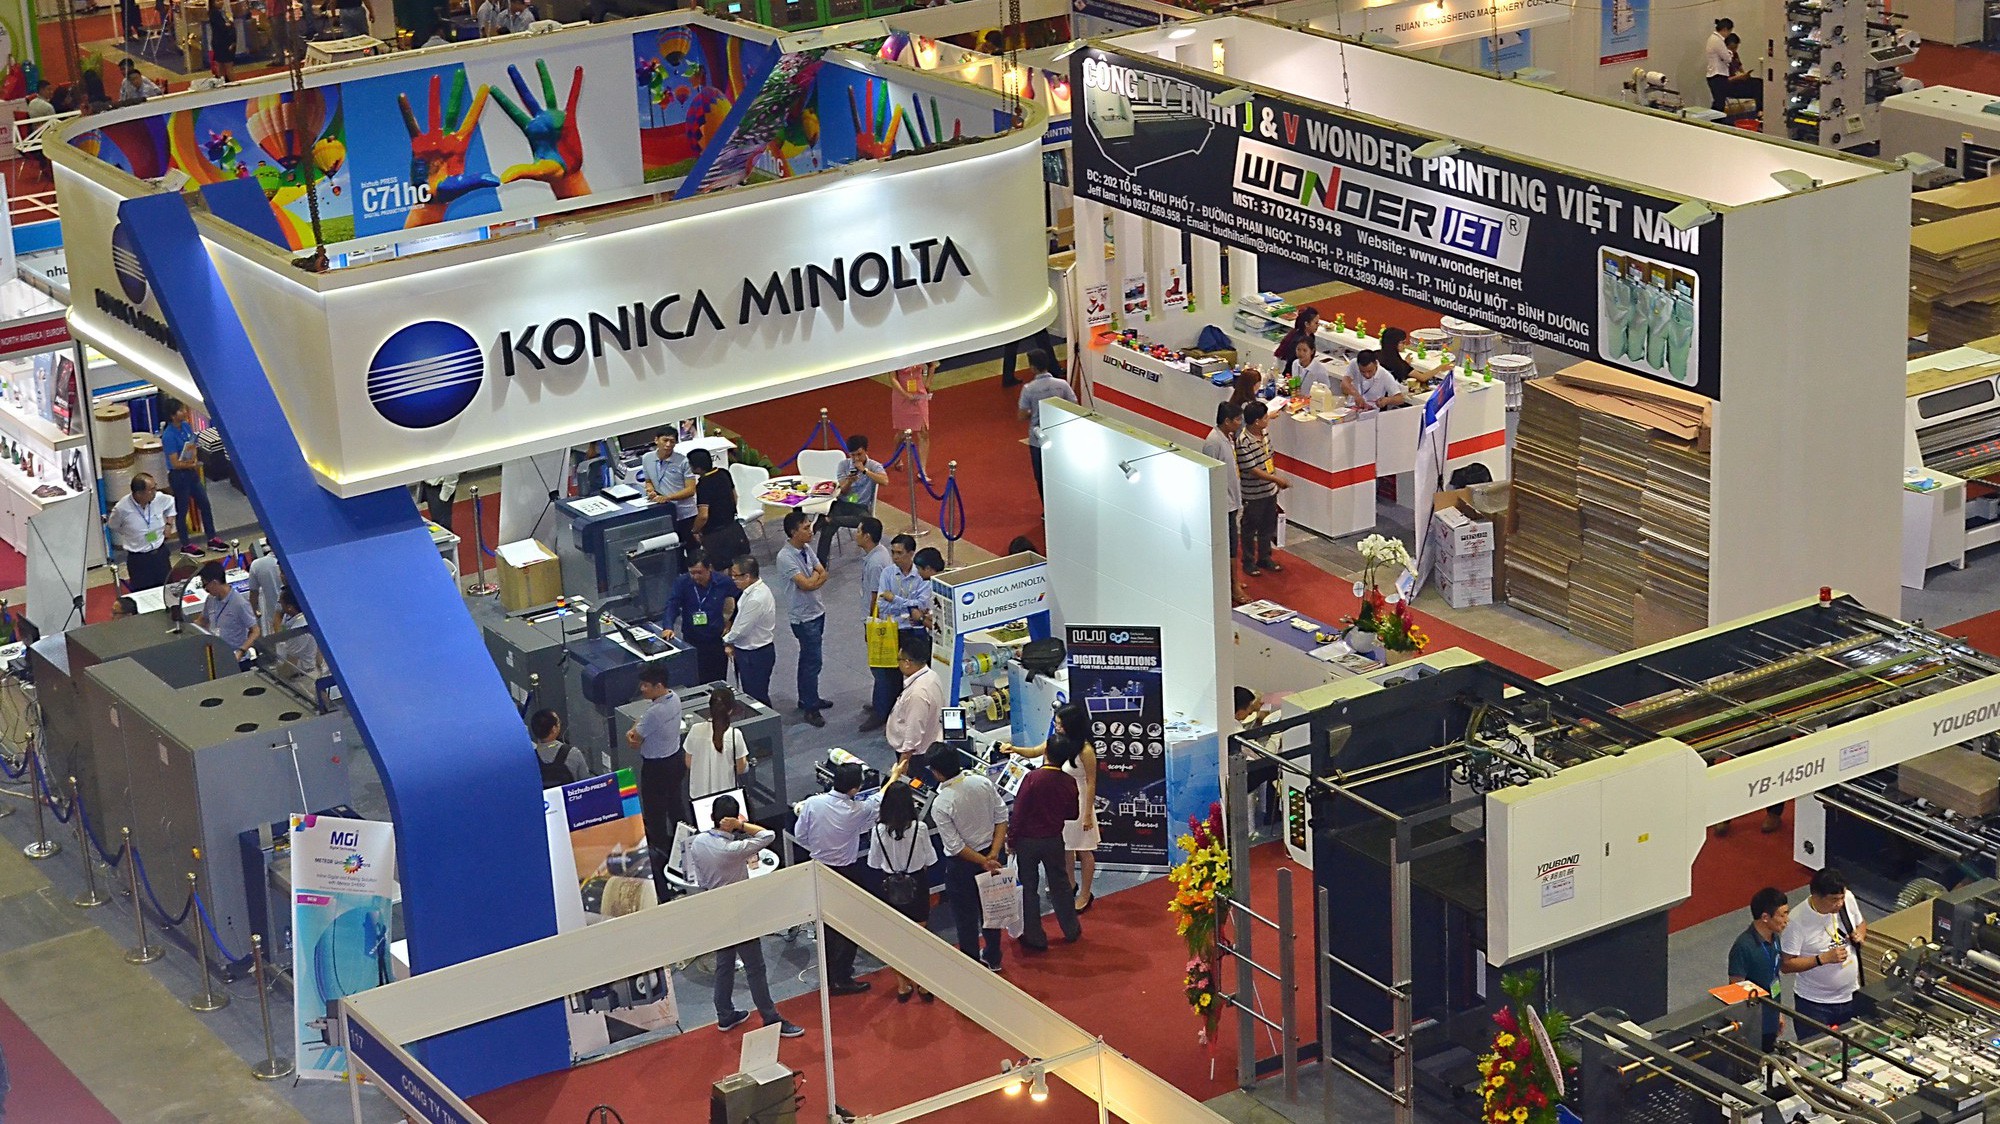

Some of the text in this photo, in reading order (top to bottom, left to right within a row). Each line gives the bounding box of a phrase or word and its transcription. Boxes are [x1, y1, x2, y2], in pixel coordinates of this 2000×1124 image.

[1395, 21, 1421, 33] RUIAN
[1083, 54, 1139, 100] CÔNG
[1143, 72, 1172, 108] TY
[1243, 101, 1254, 133] J
[1259, 106, 1279, 141] &
[1282, 111, 1300, 146] V
[1305, 118, 1413, 178] WONDER
[1421, 154, 1548, 215] PRINTING
[1556, 184, 1623, 235] VIỆT
[1632, 204, 1700, 256] NAM
[362, 181, 432, 213] C71hc
[1232, 191, 1343, 237] MST: 3702475948
[1086, 168, 1103, 184] ĐC:
[1103, 174, 1119, 189] 202
[1118, 175, 1131, 193] TỔ
[1132, 183, 1142, 196] 95
[1148, 189, 1168, 205] KHU
[1169, 194, 1189, 212] PHỐ
[1189, 201, 1196, 213] 7
[1202, 205, 1235, 226] ĐƯỜNG
[1236, 216, 1263, 236] PHẠM
[1264, 224, 1293, 245] NGỌC
[1294, 234, 1328, 255] THẠCH
[1335, 247, 1345, 262] P.
[1346, 251, 1370, 269] HIỆP
[1372, 258, 1408, 280] THÀNH
[1416, 271, 1432, 289] TP.
[1434, 277, 1457, 295] THỦ
[1459, 282, 1482, 303] DẦU
[1484, 291, 1508, 314] MỘT
[1517, 301, 1545, 322] BÌNH
[1547, 311, 1590, 337] DƯƠNG
[1356, 229, 1524, 292] Website: www.wonderjet.net
[1087, 184, 1102, 197] Jeff
[1119, 194, 1132, 209] h/p
[1132, 199, 1181, 223] 0937.669.958
[1187, 215, 1212, 232] Email:
[1212, 224, 1310, 264] budhihalim@yahoo.com
[1316, 256, 1332, 272] Tel:
[1332, 261, 1395, 291] 0274.3899.499
[1401, 283, 1431, 303] Email:
[1432, 294, 1590, 352] wonder.printing2016@gmail.com
[500, 235, 971, 377] KONICA MINOLTA
[46, 326, 67, 338] EUROPE
[977, 576, 1046, 600] KONICA MINOLTA
[962, 606, 994, 622] bizhub
[994, 601, 1018, 613] PRESS
[1072, 654, 1157, 667] DIGITAL SOLUTIONS
[567, 781, 607, 797] bizhub PRESS
[1747, 757, 1825, 798] YB-1450H
[585, 817, 602, 825] Printing
[602, 812, 619, 821] System
[1537, 853, 1580, 876] YOUBOND
